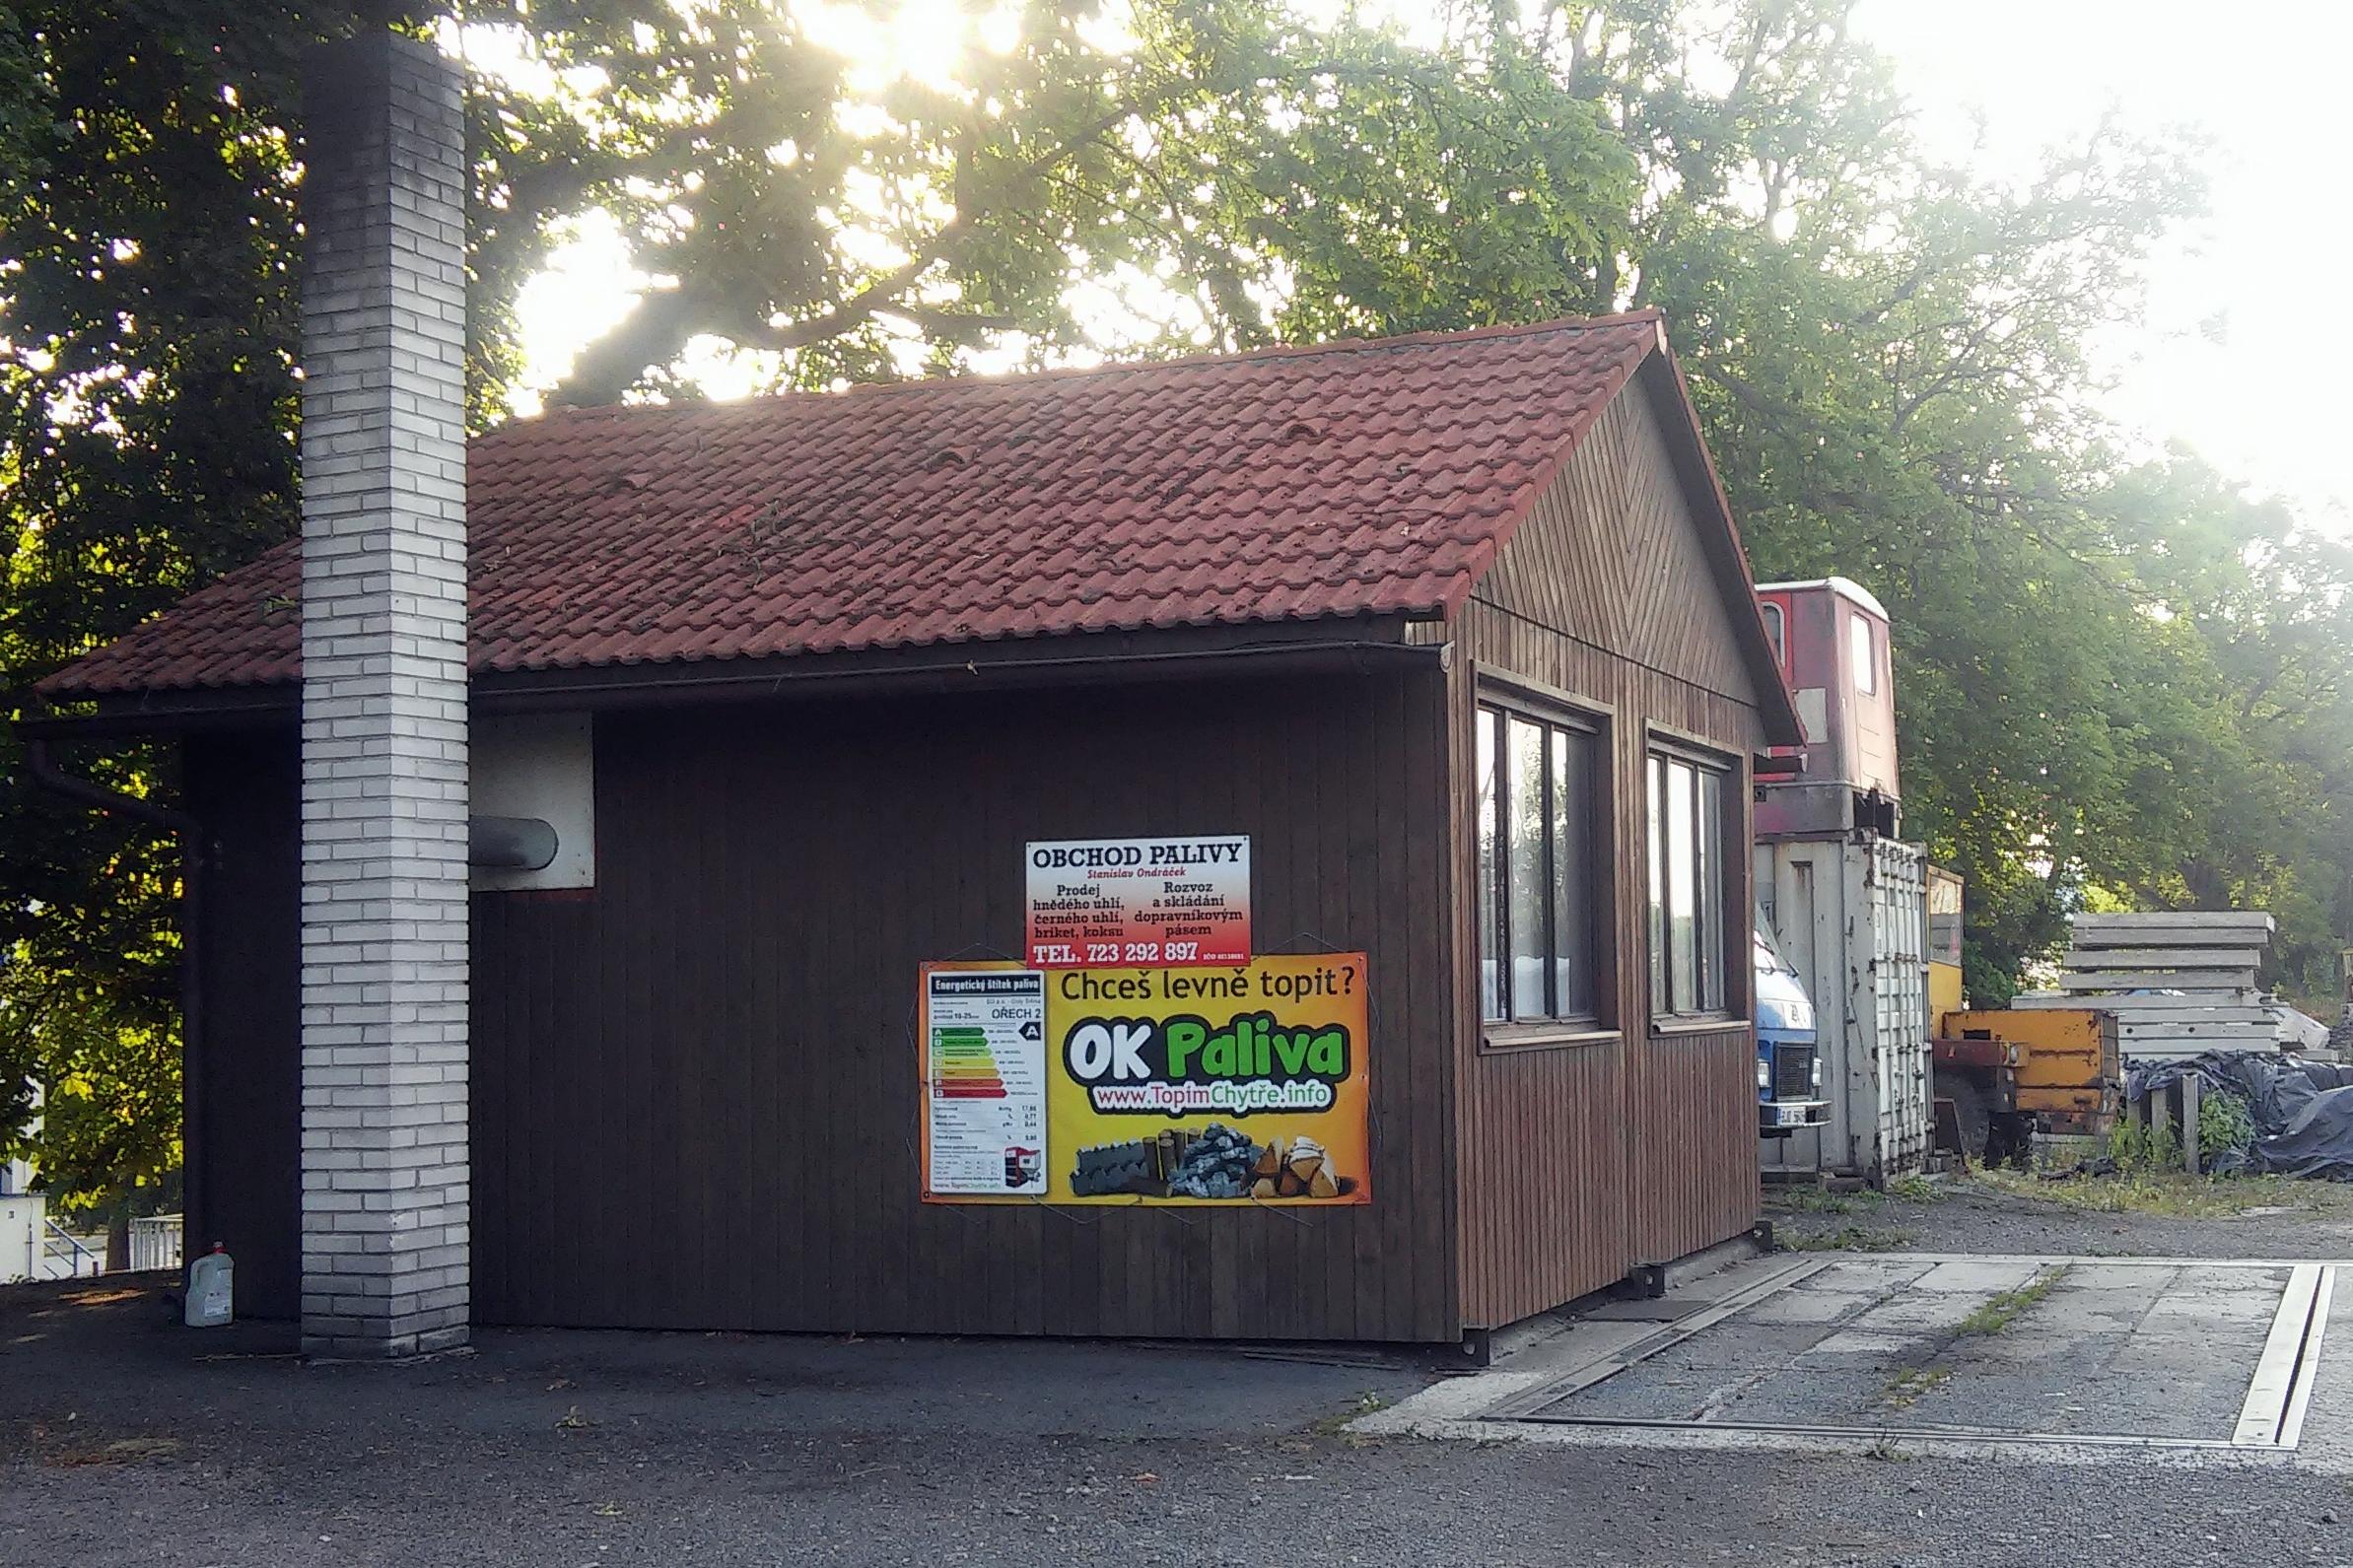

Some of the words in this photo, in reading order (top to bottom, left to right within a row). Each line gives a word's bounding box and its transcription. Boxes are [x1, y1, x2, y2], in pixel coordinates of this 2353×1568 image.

[1033, 847, 1142, 868] OBCHOD
[1149, 843, 1242, 864] PALIVY
[1087, 868, 1134, 879] Stanislav
[1137, 866, 1187, 877] Ondráček
[1057, 884, 1100, 899] Prodej
[1163, 881, 1213, 894] Rozvoz
[1033, 897, 1090, 912] hnědého
[1093, 897, 1125, 911] uhlí,
[1152, 899, 1160, 908] a
[1164, 894, 1224, 908] skládání
[1034, 912, 1089, 924] černého
[1092, 911, 1124, 924] uhlí,
[1134, 909, 1243, 924] dopravníkovým
[1035, 926, 1079, 940] briket,
[1165, 923, 1211, 938] pásem
[1033, 944, 1081, 963] TEL.
[1086, 943, 1120, 962] 723
[1125, 943, 1159, 962] 292
[1164, 941, 1199, 961] 897
[935, 980, 985, 991] Energetický
[1013, 978, 1039, 990] paliva
[1061, 970, 1151, 1000] Chceš
[1163, 968, 1249, 999] levně
[1260, 966, 1355, 1003] topit?
[992, 1006, 1032, 1019] OŘECH
[1034, 1009, 1041, 1019] 2
[1025, 1025, 1039, 1037] A
[1070, 1023, 1151, 1079] OK
[1166, 1017, 1345, 1079] Paliva
